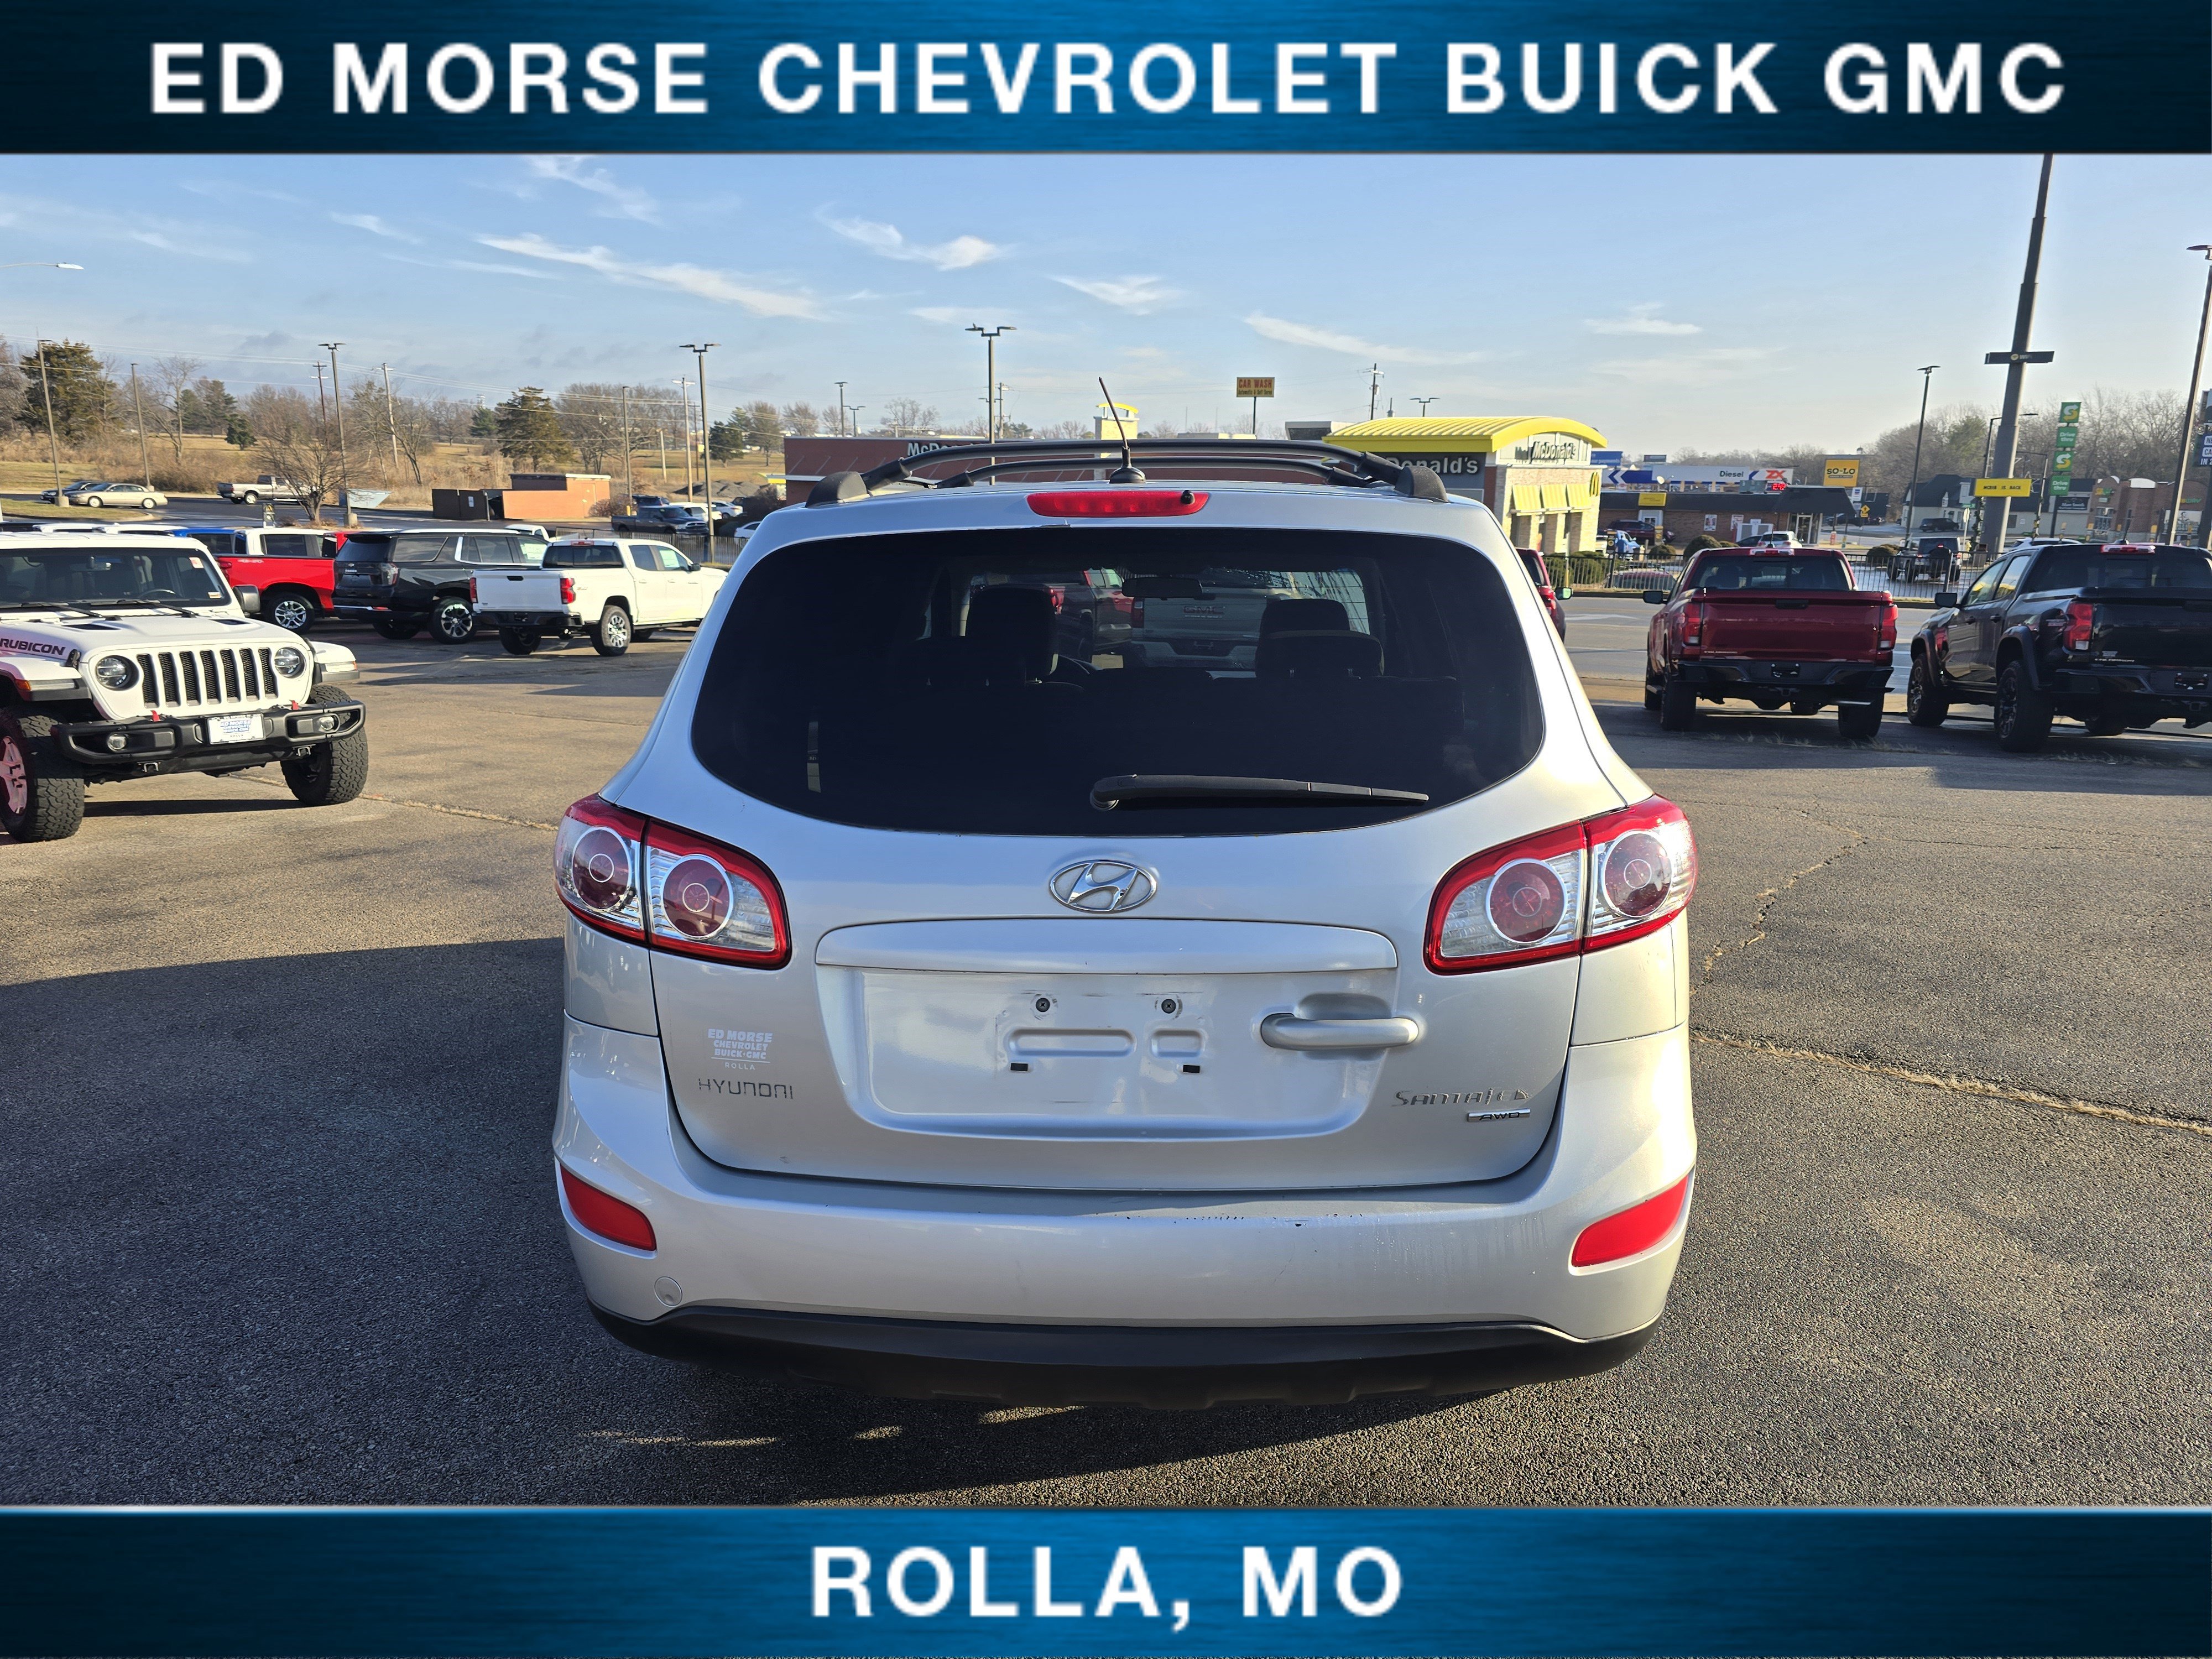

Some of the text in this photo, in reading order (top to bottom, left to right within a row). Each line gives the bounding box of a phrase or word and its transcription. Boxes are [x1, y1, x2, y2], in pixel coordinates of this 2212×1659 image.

[1239, 379, 1272, 388] CAR WASH
[1531, 441, 1576, 460] McDonald's
[1183, 606, 1225, 614] GMC
[0, 638, 66, 655] RUBICON
[707, 1028, 773, 1043] ED MORSE
[713, 1040, 768, 1051] CHEVROLET
[725, 1062, 755, 1071] ROLLA
[698, 1078, 794, 1099] HYUNDAI
[1479, 1112, 1521, 1121] AWD
